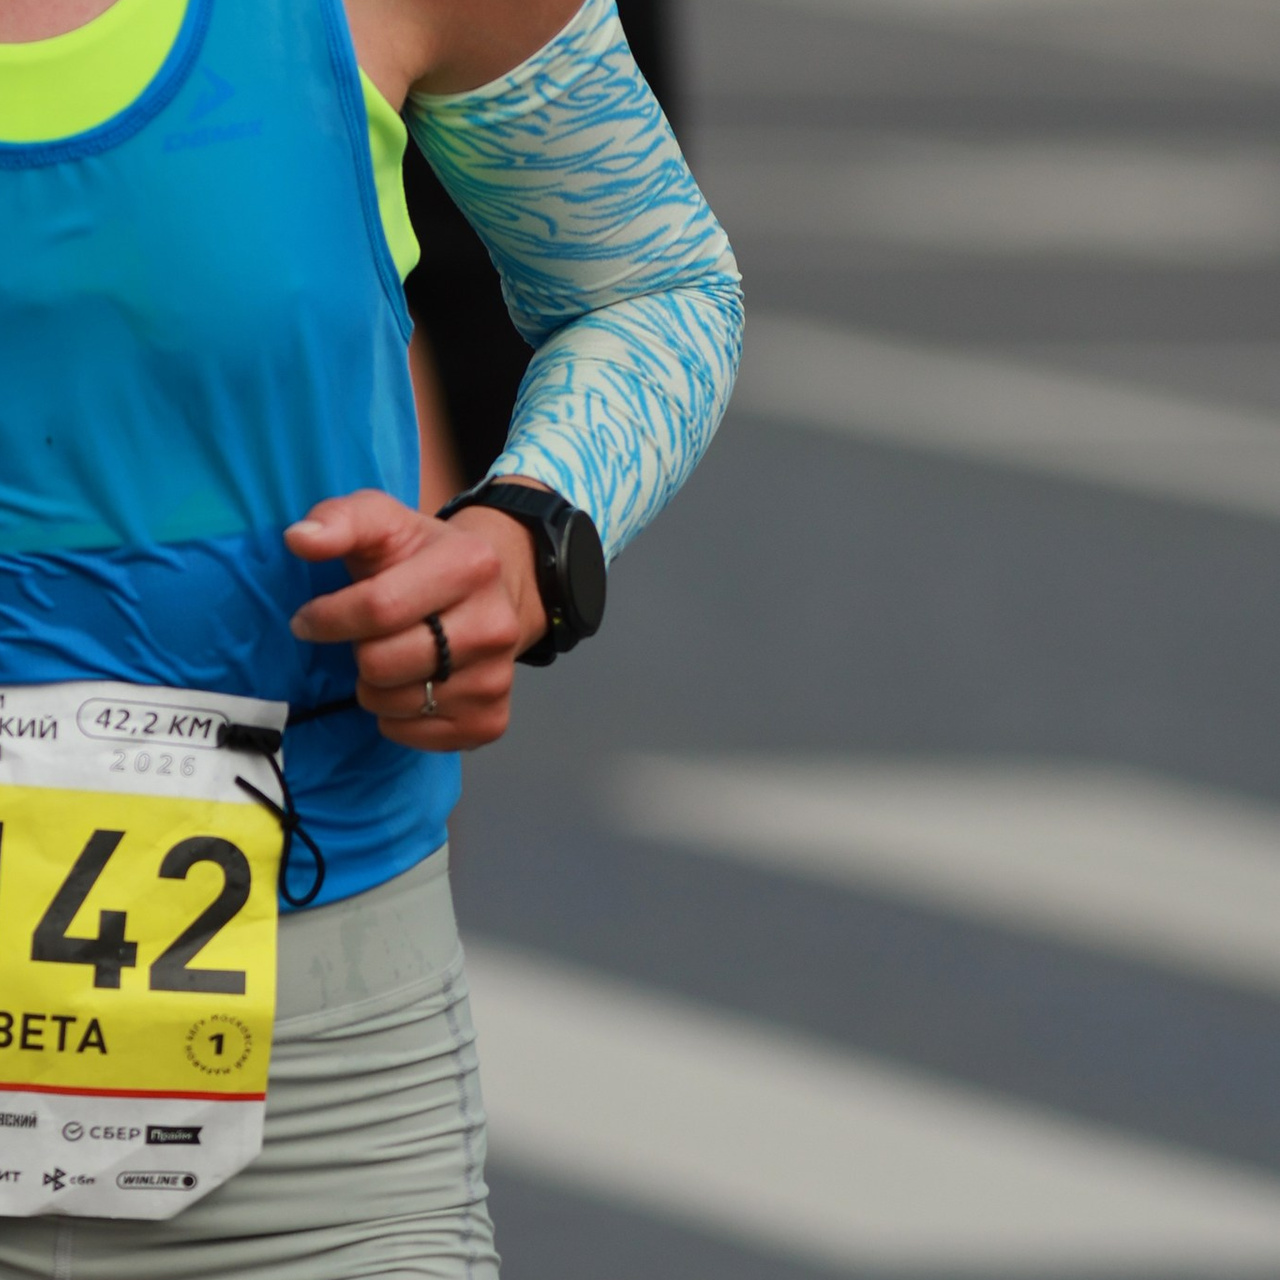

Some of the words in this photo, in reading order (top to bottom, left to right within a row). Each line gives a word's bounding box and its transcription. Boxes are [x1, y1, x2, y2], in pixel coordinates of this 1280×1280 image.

[95, 708, 159, 735] 42,2
[169, 714, 213, 739] КМ
[208, 1032, 224, 1056] 1
[89, 1126, 141, 1141] СБЕР
[122, 1175, 181, 1187] WINLINE
